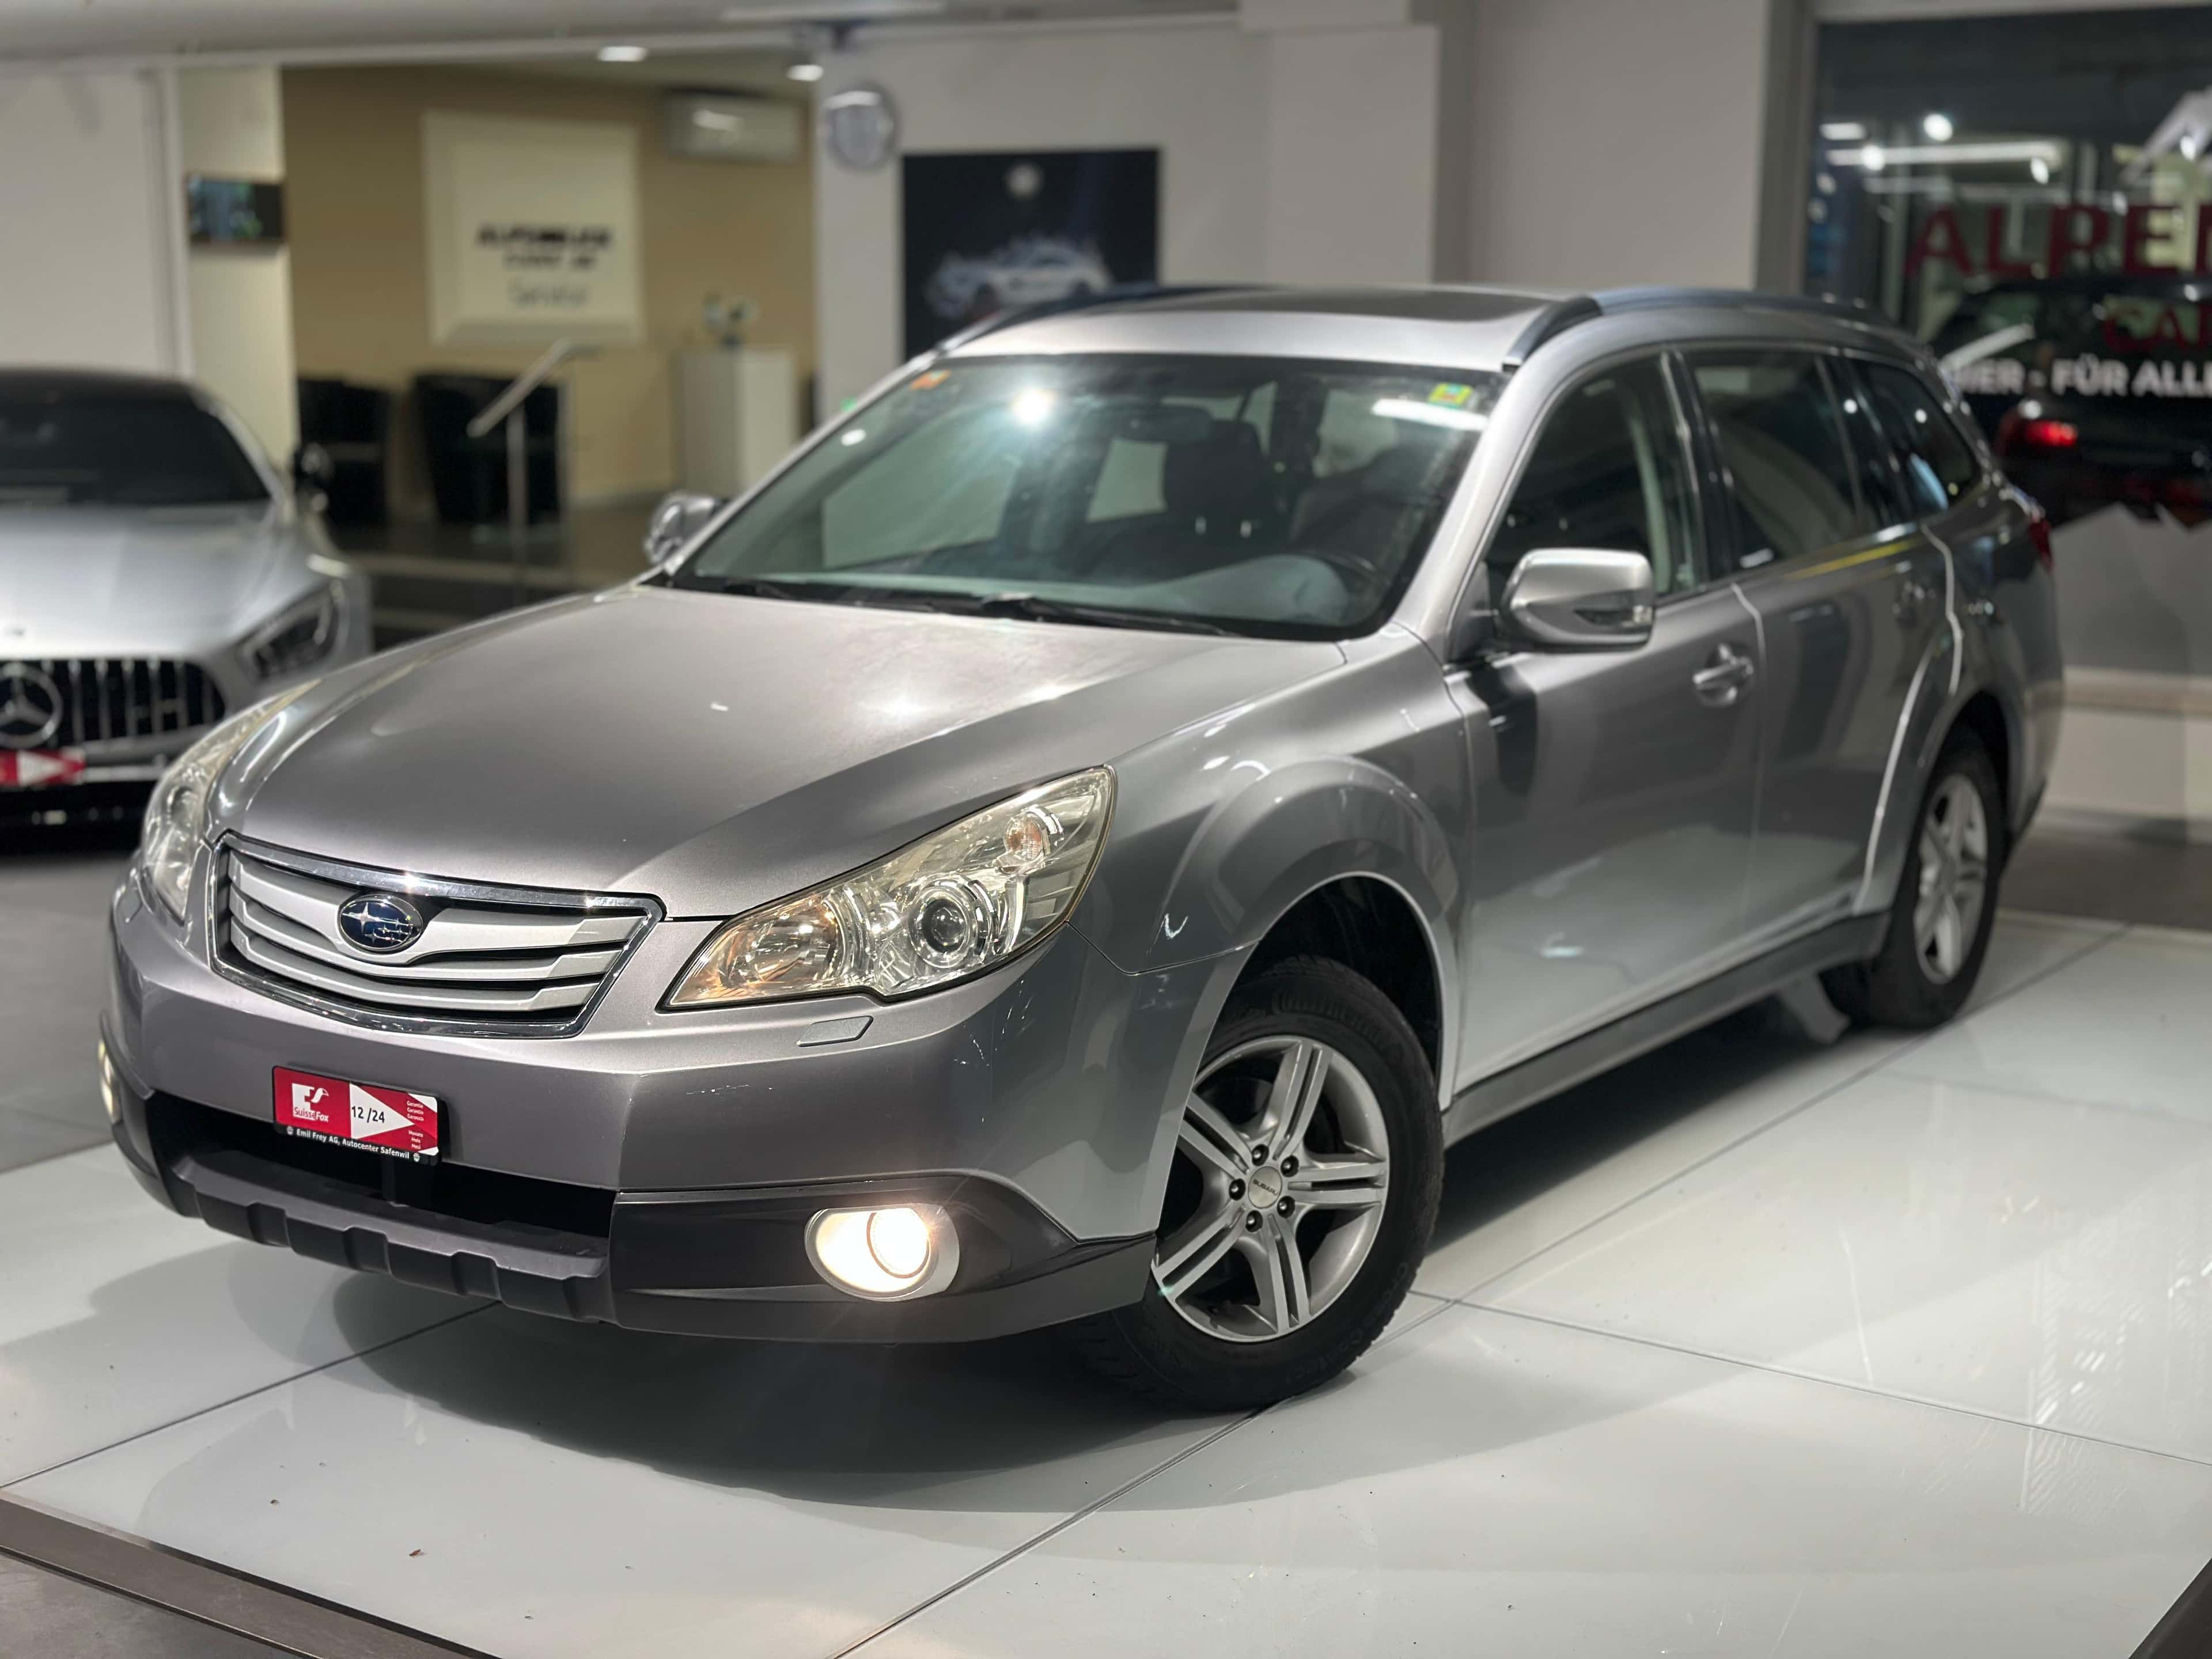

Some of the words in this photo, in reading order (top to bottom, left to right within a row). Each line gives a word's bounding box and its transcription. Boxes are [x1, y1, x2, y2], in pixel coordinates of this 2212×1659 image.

[1905, 202, 2212, 278] ALPE
[2104, 302, 2212, 350] CA
[2051, 353, 2130, 396] FÜR
[294, 1107, 329, 1123] SuisseFox
[297, 1128, 310, 1138] Emil
[312, 1132, 327, 1143] Frey
[342, 1138, 379, 1152] Autocenter
[380, 1146, 410, 1159] Safenwil
[1252, 1179, 1279, 1196] SUBARU
